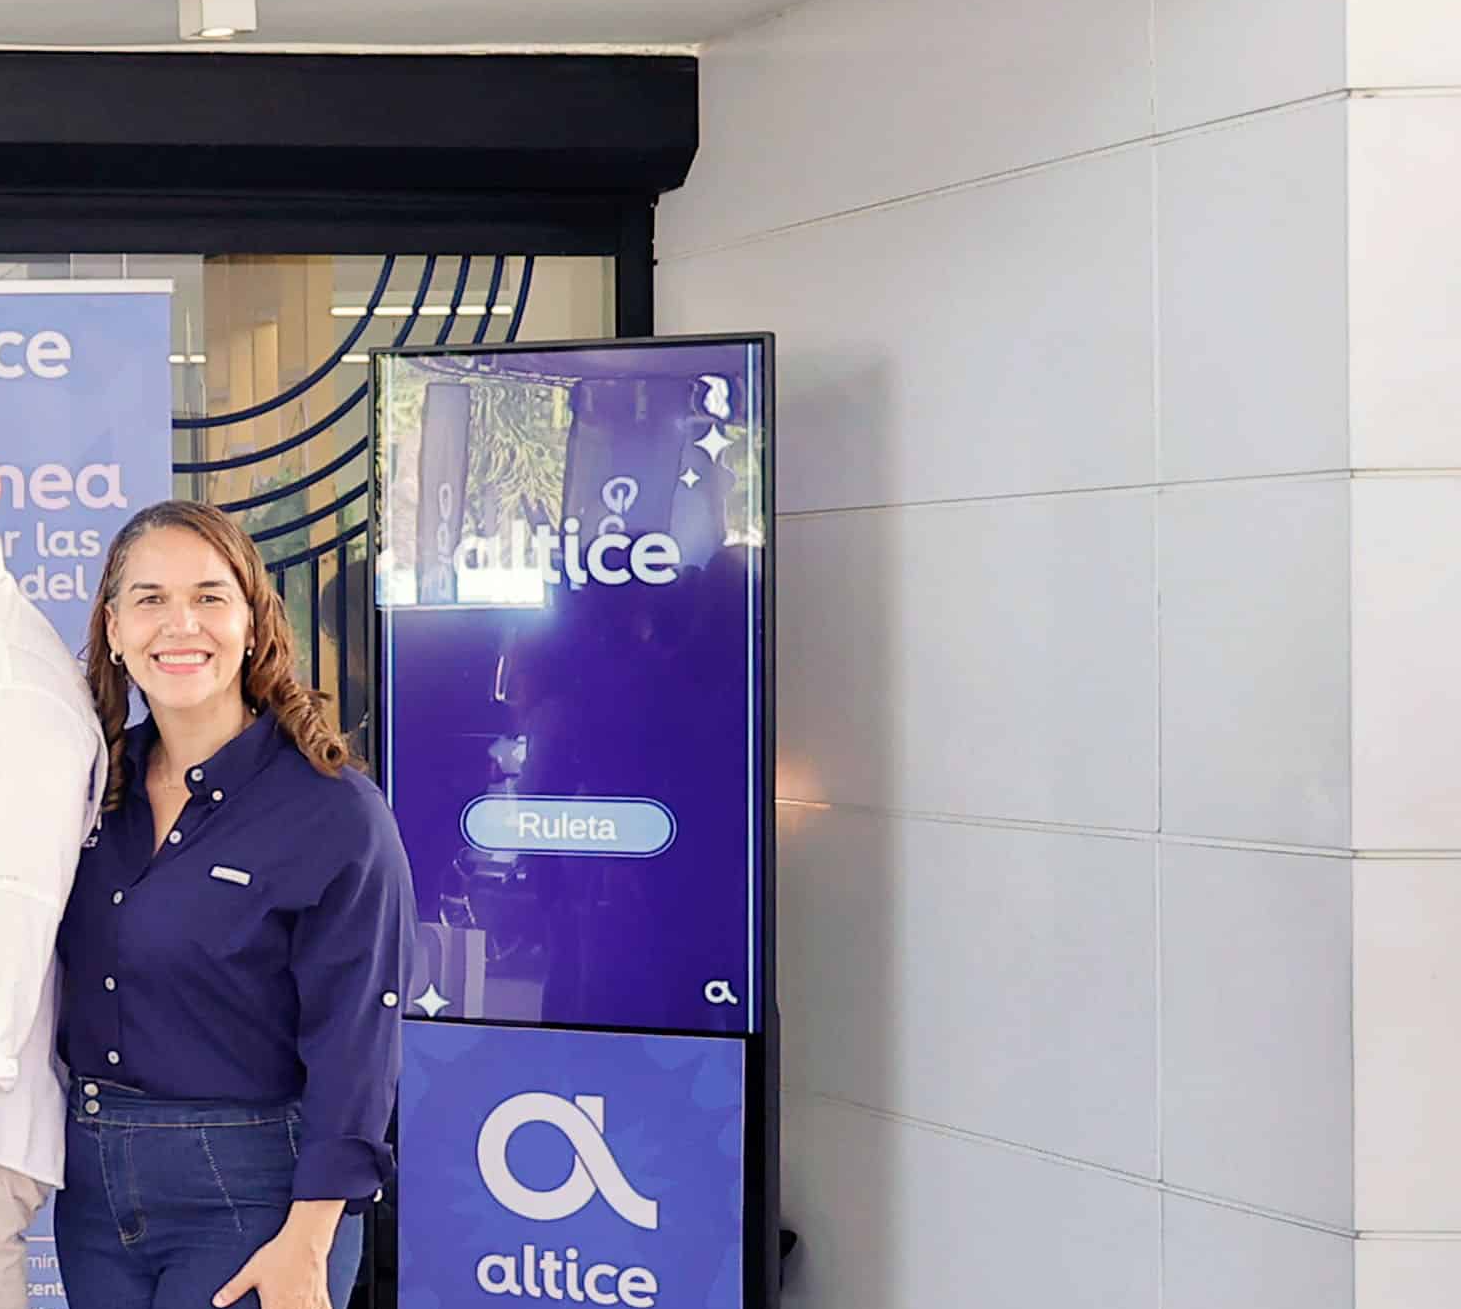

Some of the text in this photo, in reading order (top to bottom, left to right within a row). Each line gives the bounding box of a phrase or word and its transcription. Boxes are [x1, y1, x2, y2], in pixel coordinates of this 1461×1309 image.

[36, 521, 101, 558] las
[453, 517, 681, 586] altice
[20, 564, 88, 602] del
[518, 809, 616, 842] Ruleta
[476, 1244, 658, 1308] altice
